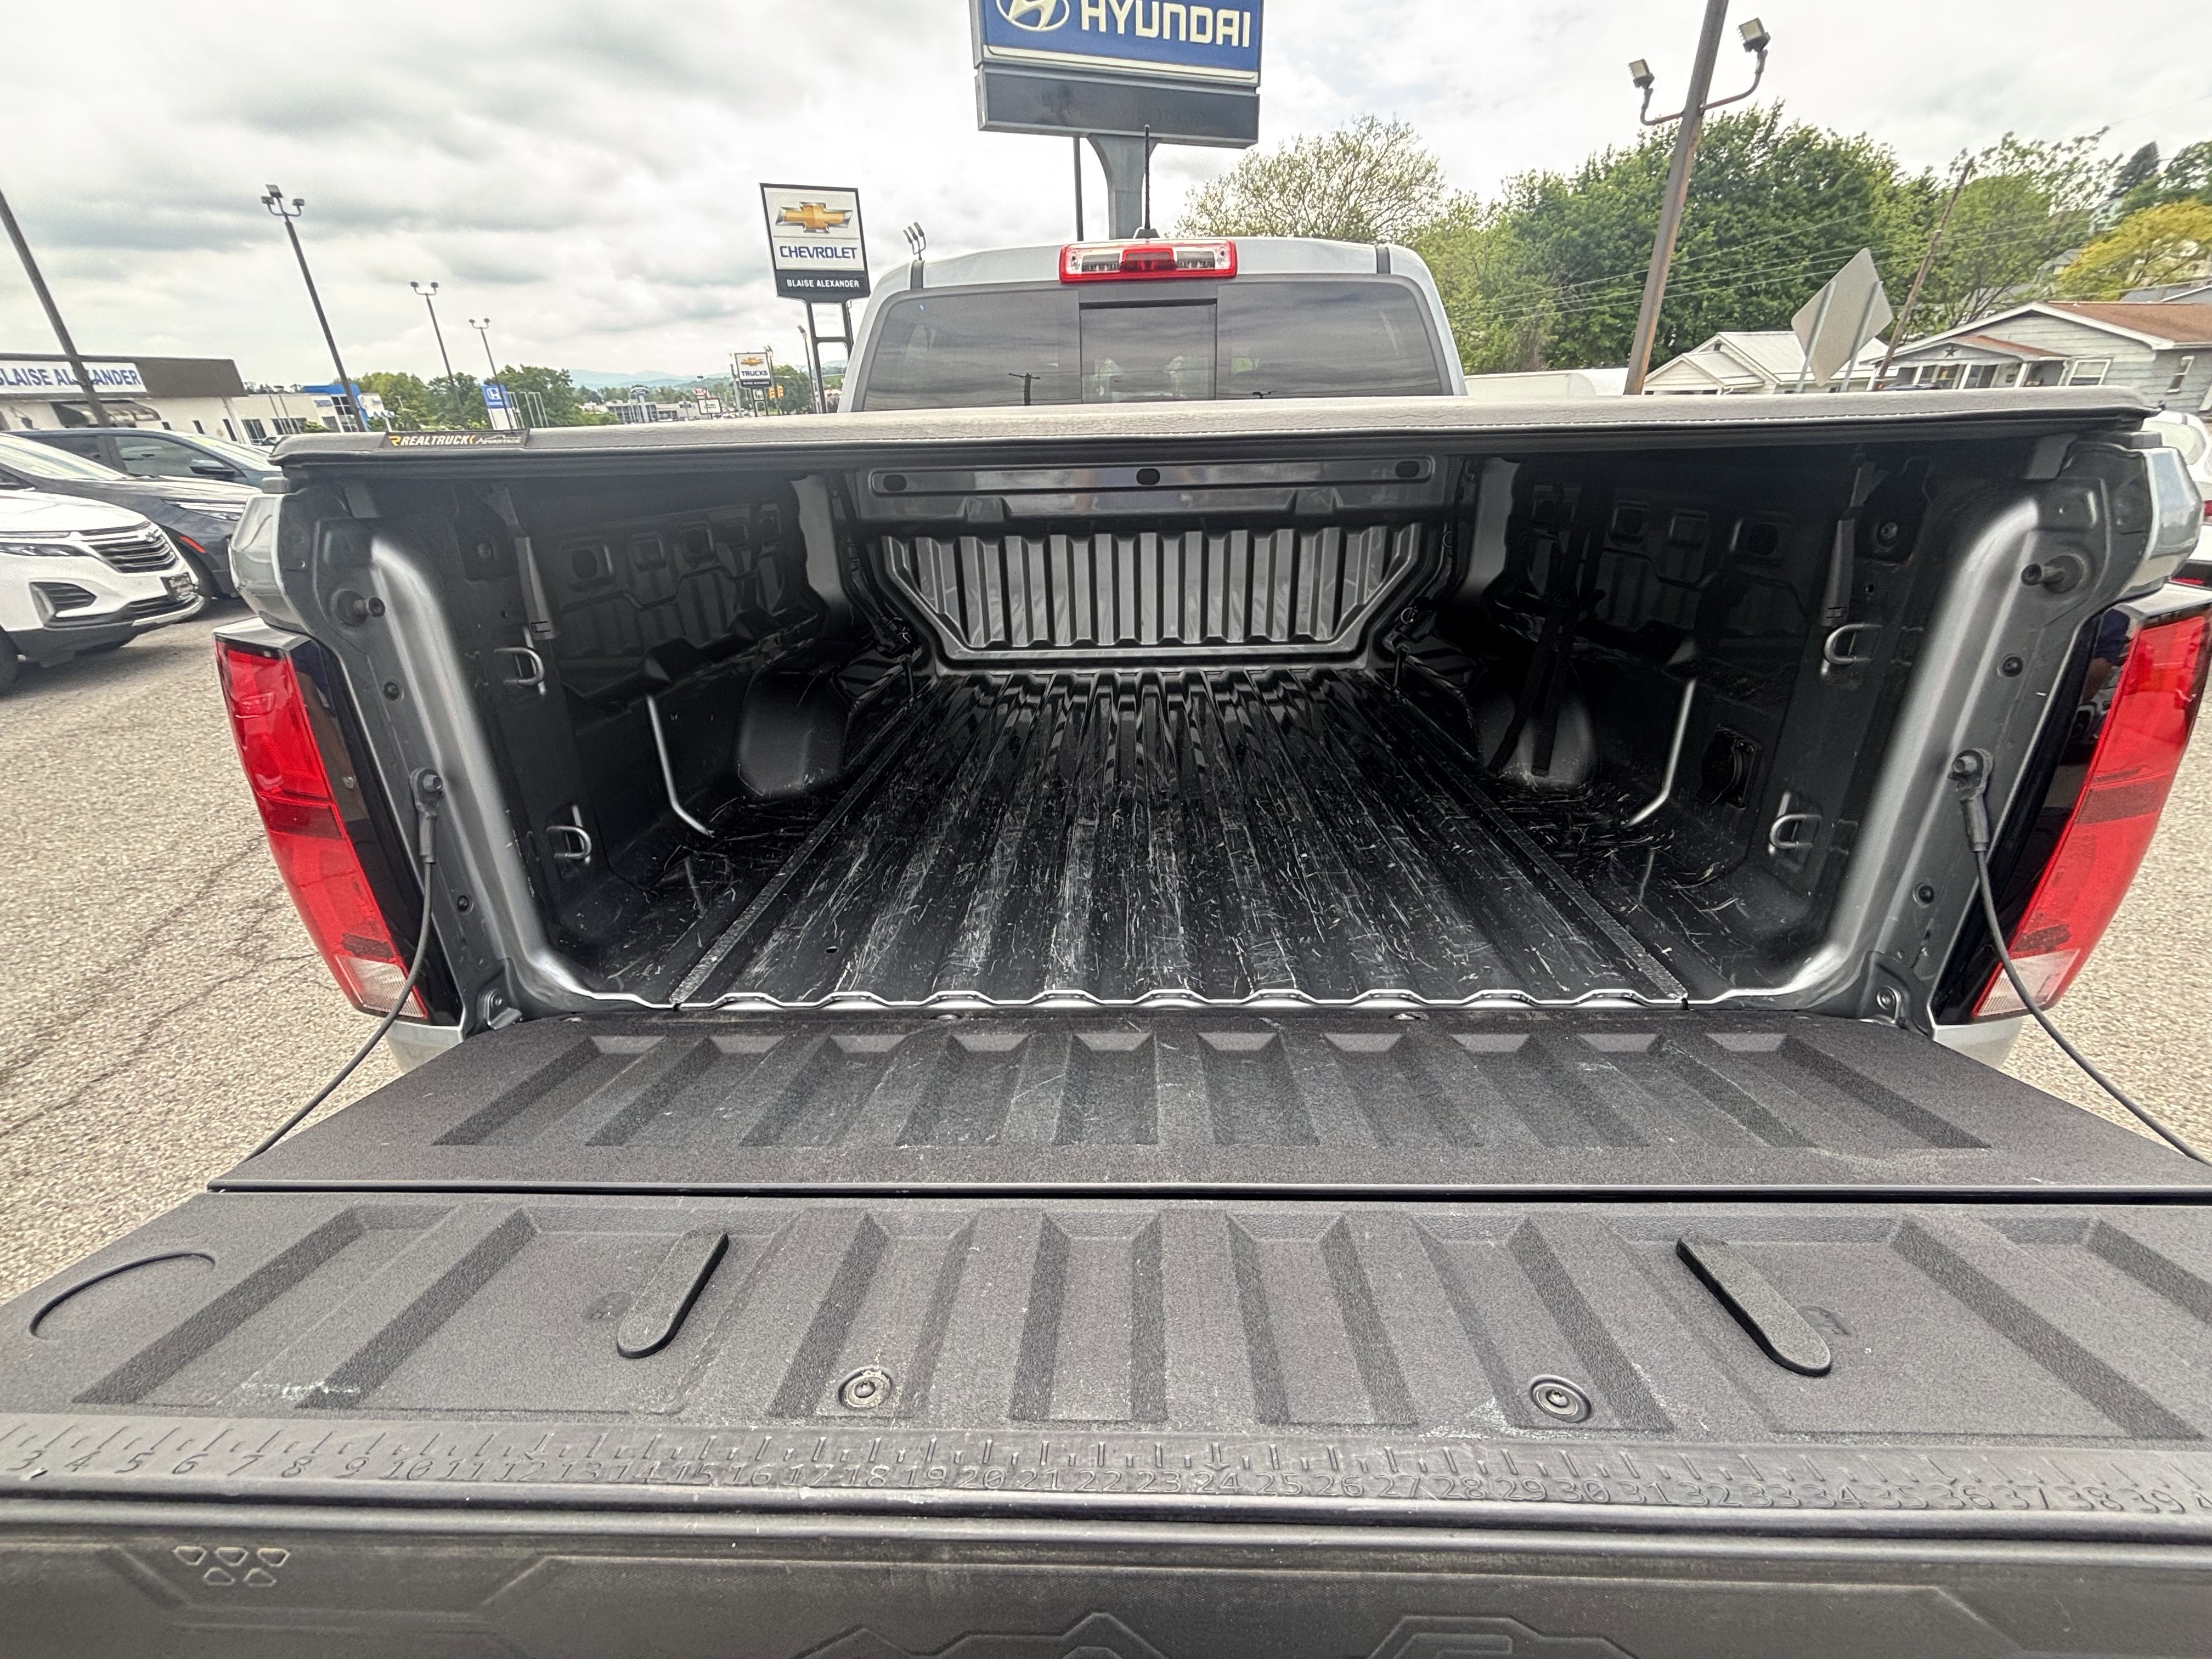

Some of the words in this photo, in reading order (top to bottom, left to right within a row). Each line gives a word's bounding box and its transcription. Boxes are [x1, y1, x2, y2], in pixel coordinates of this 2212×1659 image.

[1081, 0, 1251, 48] HYUNDAI
[780, 245, 857, 259] CHEVROLET
[787, 279, 814, 287] BLAISE
[816, 279, 860, 287] ALEXANDER
[0, 368, 54, 386] LAISE
[53, 369, 142, 386] ALANDER
[401, 435, 470, 446] REALTRUCK
[7, 1450, 43, 1471] 3
[65, 1451, 100, 1472] 4
[115, 1452, 154, 1474] 5
[172, 1454, 208, 1475] 6
[225, 1454, 264, 1476] 7
[281, 1456, 313, 1478] 8
[334, 1457, 368, 1479] 9
[380, 1458, 434, 1481] 10
[438, 1458, 491, 1481] 11
[496, 1460, 546, 1482] 12
[555, 1460, 602, 1482] 13
[606, 1460, 665, 1483] 14
[669, 1461, 720, 1483] 15
[723, 1464, 772, 1486] 16
[782, 1464, 834, 1487] 17
[841, 1464, 890, 1487] 18
[899, 1465, 947, 1488] 19
[956, 1465, 1006, 1490] 20
[1017, 1468, 1064, 1491] 21
[1076, 1470, 1122, 1492] 22
[1136, 1470, 1182, 1493] 23
[1195, 1472, 1243, 1494] 24
[1255, 1472, 1304, 1496] 25
[1316, 1474, 1365, 1497] 26
[1373, 1475, 1421, 1498] 27
[1434, 1476, 1487, 1499] 28
[1496, 1477, 1548, 1502] 29
[1559, 1480, 1611, 1504] 30
[1617, 1482, 1675, 1505] 31
[1679, 1482, 1743, 1507] 32
[1743, 1484, 1802, 1508] 33
[1802, 1485, 1864, 1509] 34
[1869, 1486, 1929, 1510] 35
[1935, 1485, 1995, 1510] 36
[1993, 1486, 2050, 1510] 37
[2118, 1488, 2186, 1514] 39
